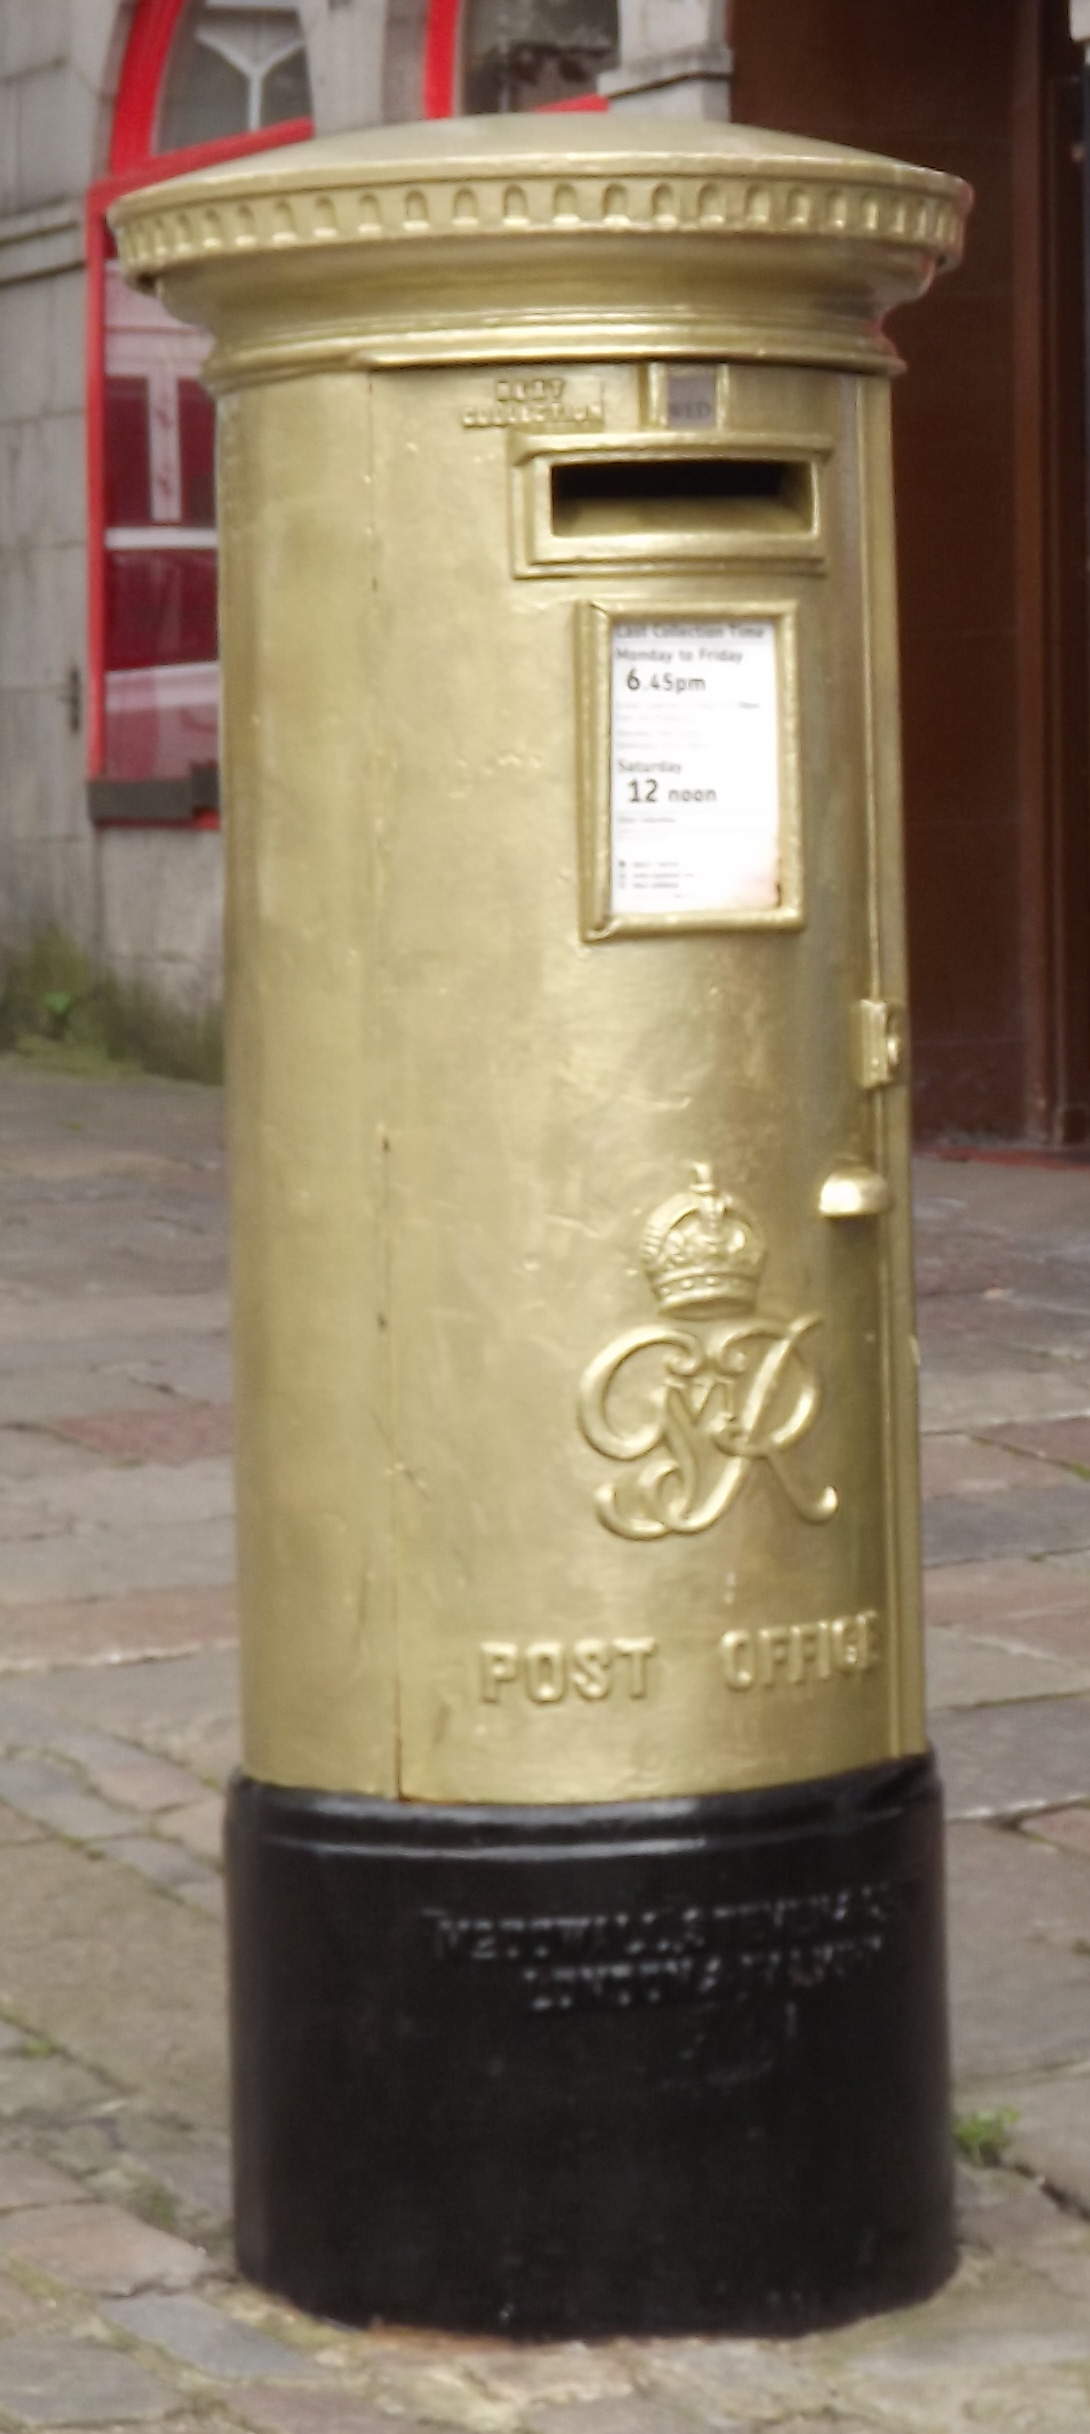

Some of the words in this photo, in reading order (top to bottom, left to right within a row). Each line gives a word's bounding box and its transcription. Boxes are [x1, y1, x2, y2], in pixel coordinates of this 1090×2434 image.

[616, 648, 673, 664] Monday
[678, 650, 694, 662] to
[698, 648, 743, 664] Friday
[626, 667, 706, 694] 6.45pm
[617, 759, 682, 774] Saturday
[628, 778, 659, 803] 12
[667, 788, 718, 802] noon
[478, 1635, 657, 1704] POST
[720, 1609, 879, 1692] OFFICE
